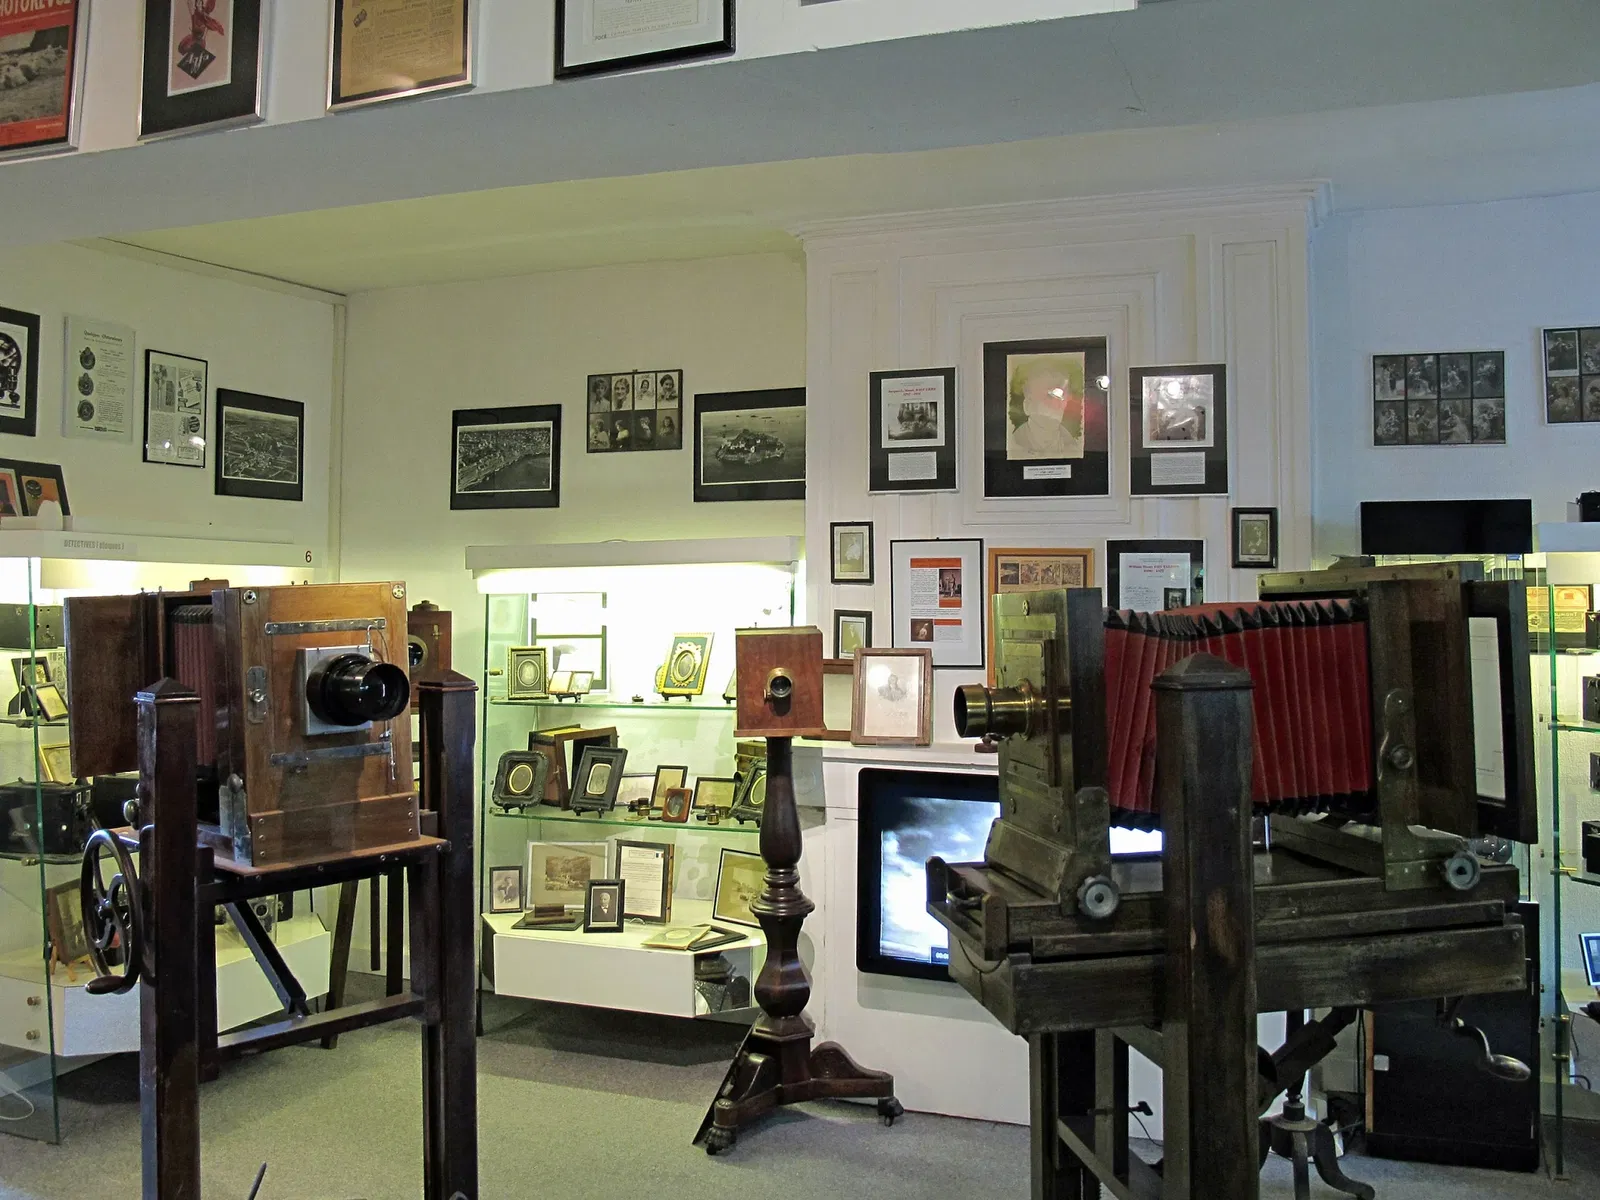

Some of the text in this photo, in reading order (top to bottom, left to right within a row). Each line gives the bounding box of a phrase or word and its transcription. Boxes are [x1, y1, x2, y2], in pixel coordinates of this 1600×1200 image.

[183, 51, 209, 74] Agfa
[64, 539, 96, 549] DETECTIVES
[305, 550, 312, 563] 6
